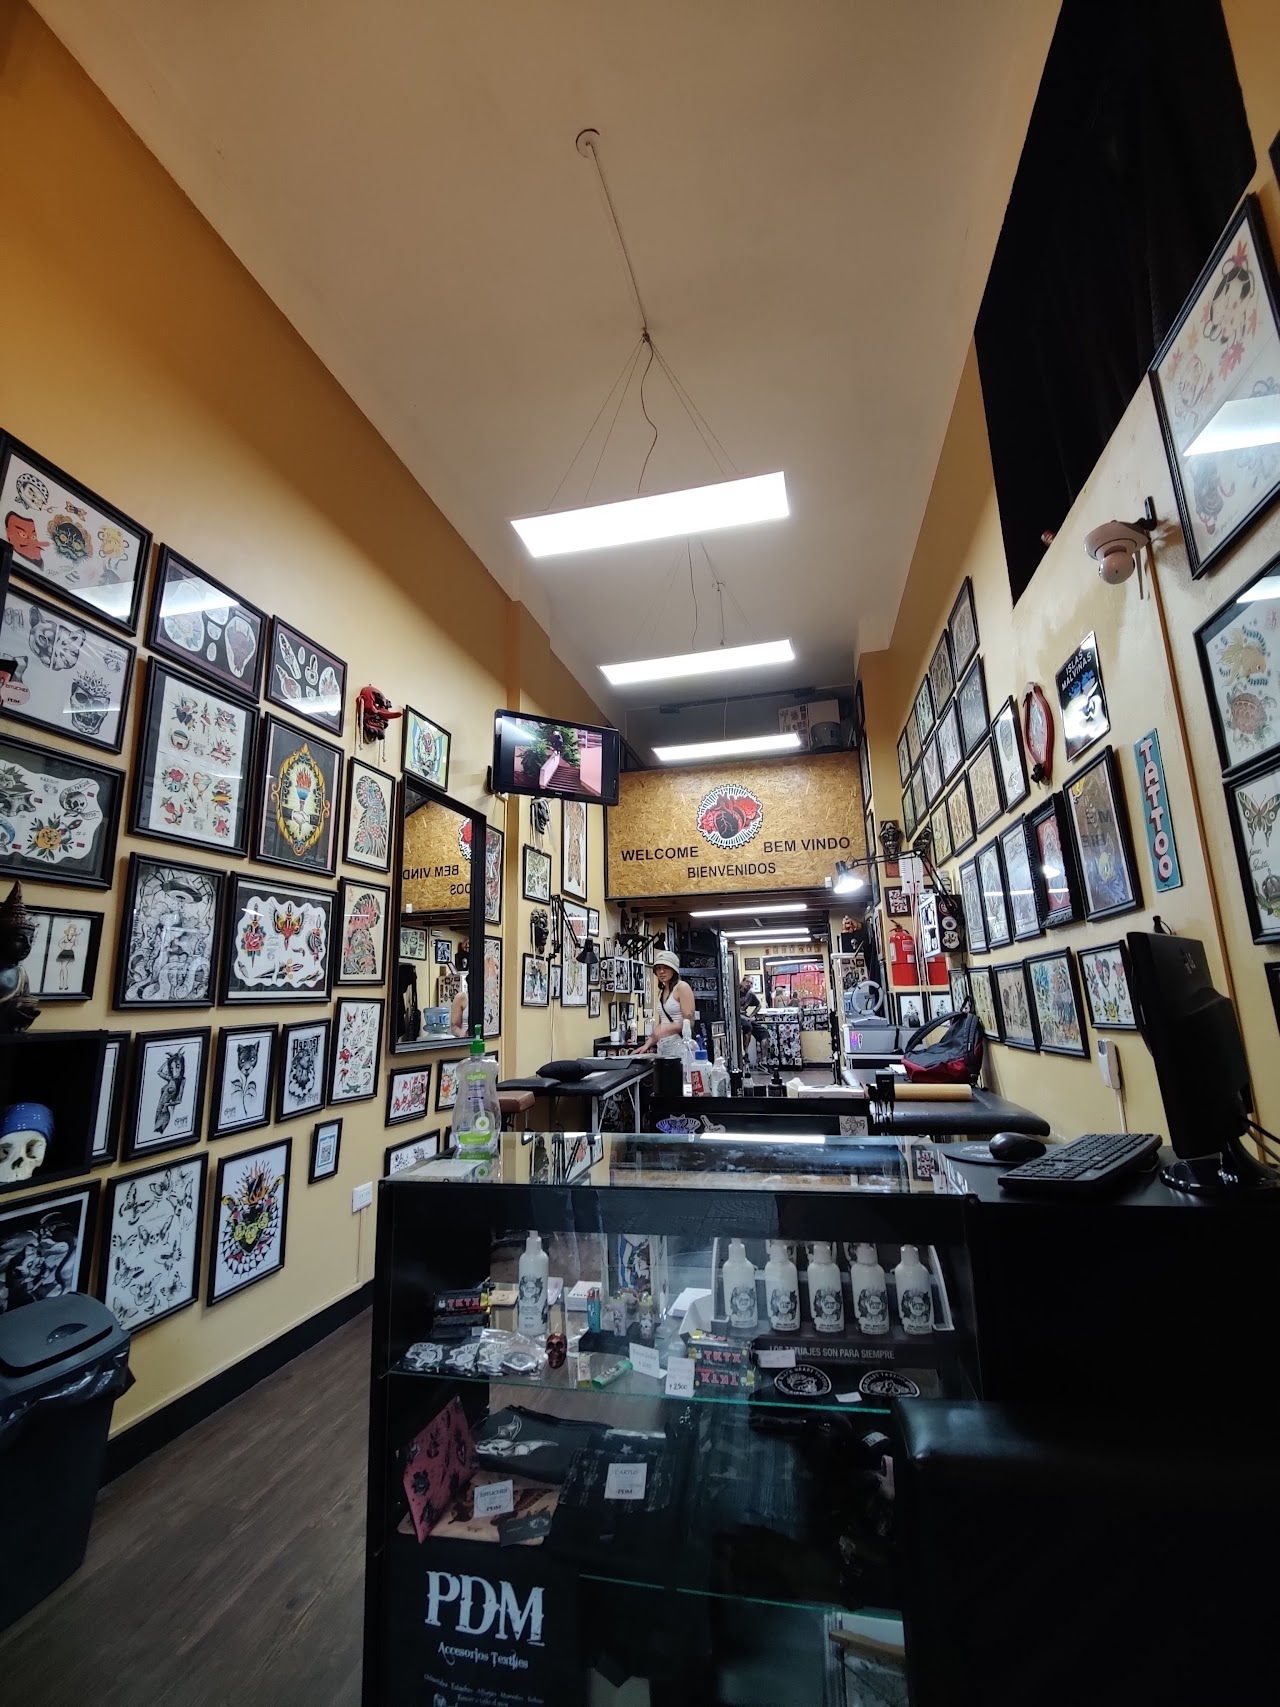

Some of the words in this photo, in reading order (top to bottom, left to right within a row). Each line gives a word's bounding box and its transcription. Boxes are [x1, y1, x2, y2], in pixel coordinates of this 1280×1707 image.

[1061, 652, 1092, 691] MALVINAS
[1065, 650, 1084, 676] ISLAS
[1139, 740, 1173, 880] TATTOO
[763, 840, 796, 853] BEM
[801, 836, 851, 851] VINDO
[621, 846, 699, 861] WELCOME
[687, 862, 776, 879] BIENVENIDOS
[703, 1350, 742, 1365] TKTX
[822, 1347, 838, 1357] SON
[839, 1348, 860, 1358] PARA
[861, 1349, 896, 1360] SIEMPRE
[700, 1371, 738, 1387] TKTX
[424, 1570, 546, 1647] PDM
[438, 1641, 489, 1666] Accesorios
[490, 1649, 529, 1670] Textiles
